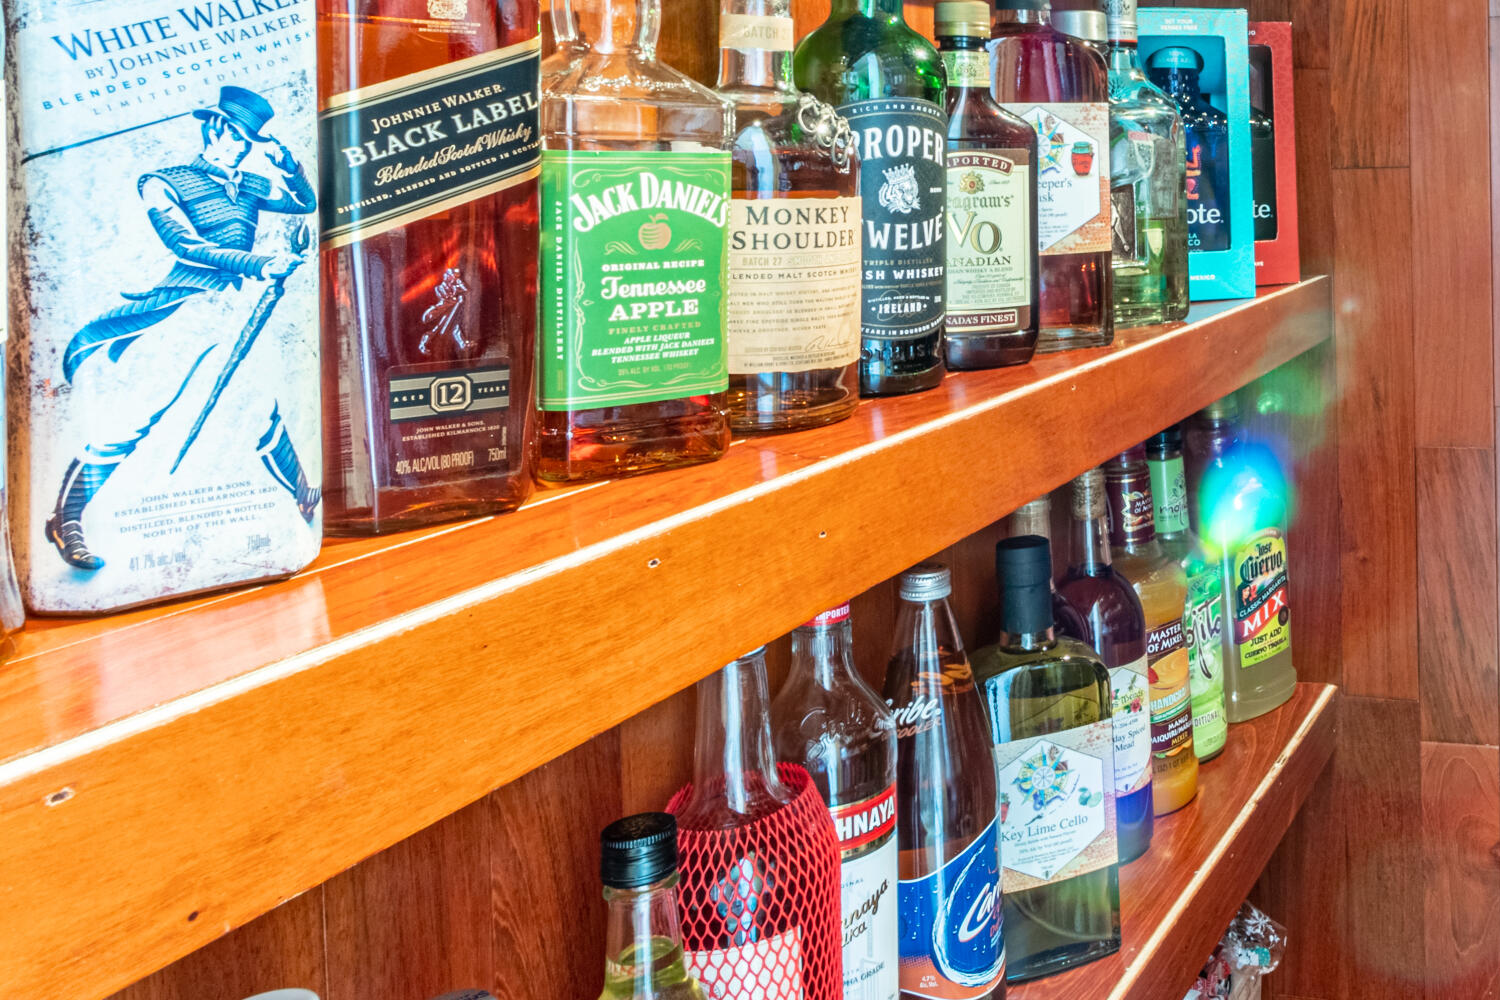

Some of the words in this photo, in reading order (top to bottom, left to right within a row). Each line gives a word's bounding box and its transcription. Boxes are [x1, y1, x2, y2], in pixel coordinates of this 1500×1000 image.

[50, 16, 178, 61] WHITE
[85, 66, 104, 80] BY
[107, 38, 212, 79] JOHNNIE
[215, 12, 303, 45] WALKER
[42, 76, 147, 110] BLENDED
[162, 51, 242, 78] SCOTCH
[92, 84, 187, 115] LIMITED
[203, 55, 290, 85] EDITION
[372, 102, 441, 134] JOHNNIE
[443, 84, 504, 108] WALKER
[852, 105, 879, 114] RICH
[342, 120, 448, 168] BLACK
[452, 92, 539, 134] LABEL
[374, 154, 439, 186] Blended
[437, 144, 483, 165] Scotch
[481, 123, 532, 150] Whisky
[947, 156, 1008, 171] PORTED
[396, 177, 435, 195] BLENDED
[439, 169, 457, 181] AND
[460, 157, 497, 173] BOTTLED
[500, 151, 510, 160] IN
[570, 182, 640, 232] JACK
[640, 172, 728, 228] DANIEL'S
[556, 201, 564, 231] JACK
[746, 206, 849, 226] MONKEY
[732, 229, 855, 250] SHOULDER
[862, 216, 943, 251] WELVE
[556, 237, 564, 282] DANIEL
[602, 262, 660, 272] ORIGINAL
[663, 259, 705, 269] RECIPE
[742, 257, 769, 266] BATCH
[807, 270, 837, 278] SCOTCH
[893, 266, 944, 279] WHISKEY
[601, 276, 707, 299] Tennessee
[608, 299, 699, 321] APPLE
[878, 302, 922, 314] IRELAND
[556, 288, 564, 360] DISTILLERY
[608, 326, 649, 335] FINELY
[653, 322, 701, 331] CRAFTED
[980, 313, 1015, 325] FINEST
[624, 336, 651, 344] APPLE
[654, 332, 690, 342] LIQUEUR
[592, 346, 633, 356] BLENDED
[635, 344, 658, 352] WITH
[659, 342, 680, 351] JACK
[611, 353, 660, 363] TENNESSEE
[662, 348, 699, 358] WHISKEY
[393, 394, 424, 403] AGED
[439, 384, 464, 405] 12
[478, 385, 507, 394] YEARS
[402, 432, 445, 442] ESTABLISHED
[446, 427, 486, 437] KILMARNOCK
[416, 426, 434, 434] JOHN
[435, 423, 461, 432] WALKER
[396, 460, 411, 475] 40%
[141, 493, 168, 504] JOHN
[173, 486, 213, 498] WALKER
[226, 480, 252, 490] SONS
[114, 500, 187, 518] ESTABLISHED
[190, 489, 256, 505] KILMARNOCK
[178, 510, 224, 523] BLENDED
[234, 501, 276, 513] BOTTLED
[143, 527, 183, 539] NORTH
[186, 523, 200, 532] OF
[205, 519, 226, 528] THE
[1256, 541, 1272, 559] Jose
[1240, 550, 1283, 584] Cuervo
[1239, 599, 1262, 618] CLASSIC
[1262, 575, 1286, 601] MARGARITA
[1243, 590, 1284, 638] MIX
[1149, 623, 1181, 643] MASTER
[1250, 632, 1268, 647] JUST
[1269, 627, 1282, 640] ADD
[1148, 643, 1160, 653] OF
[1161, 635, 1184, 651] MIXES
[1168, 714, 1189, 730] MANGO
[1001, 829, 1025, 842] Key
[1028, 824, 1057, 838] Lime
[1059, 815, 1089, 830] Cello
